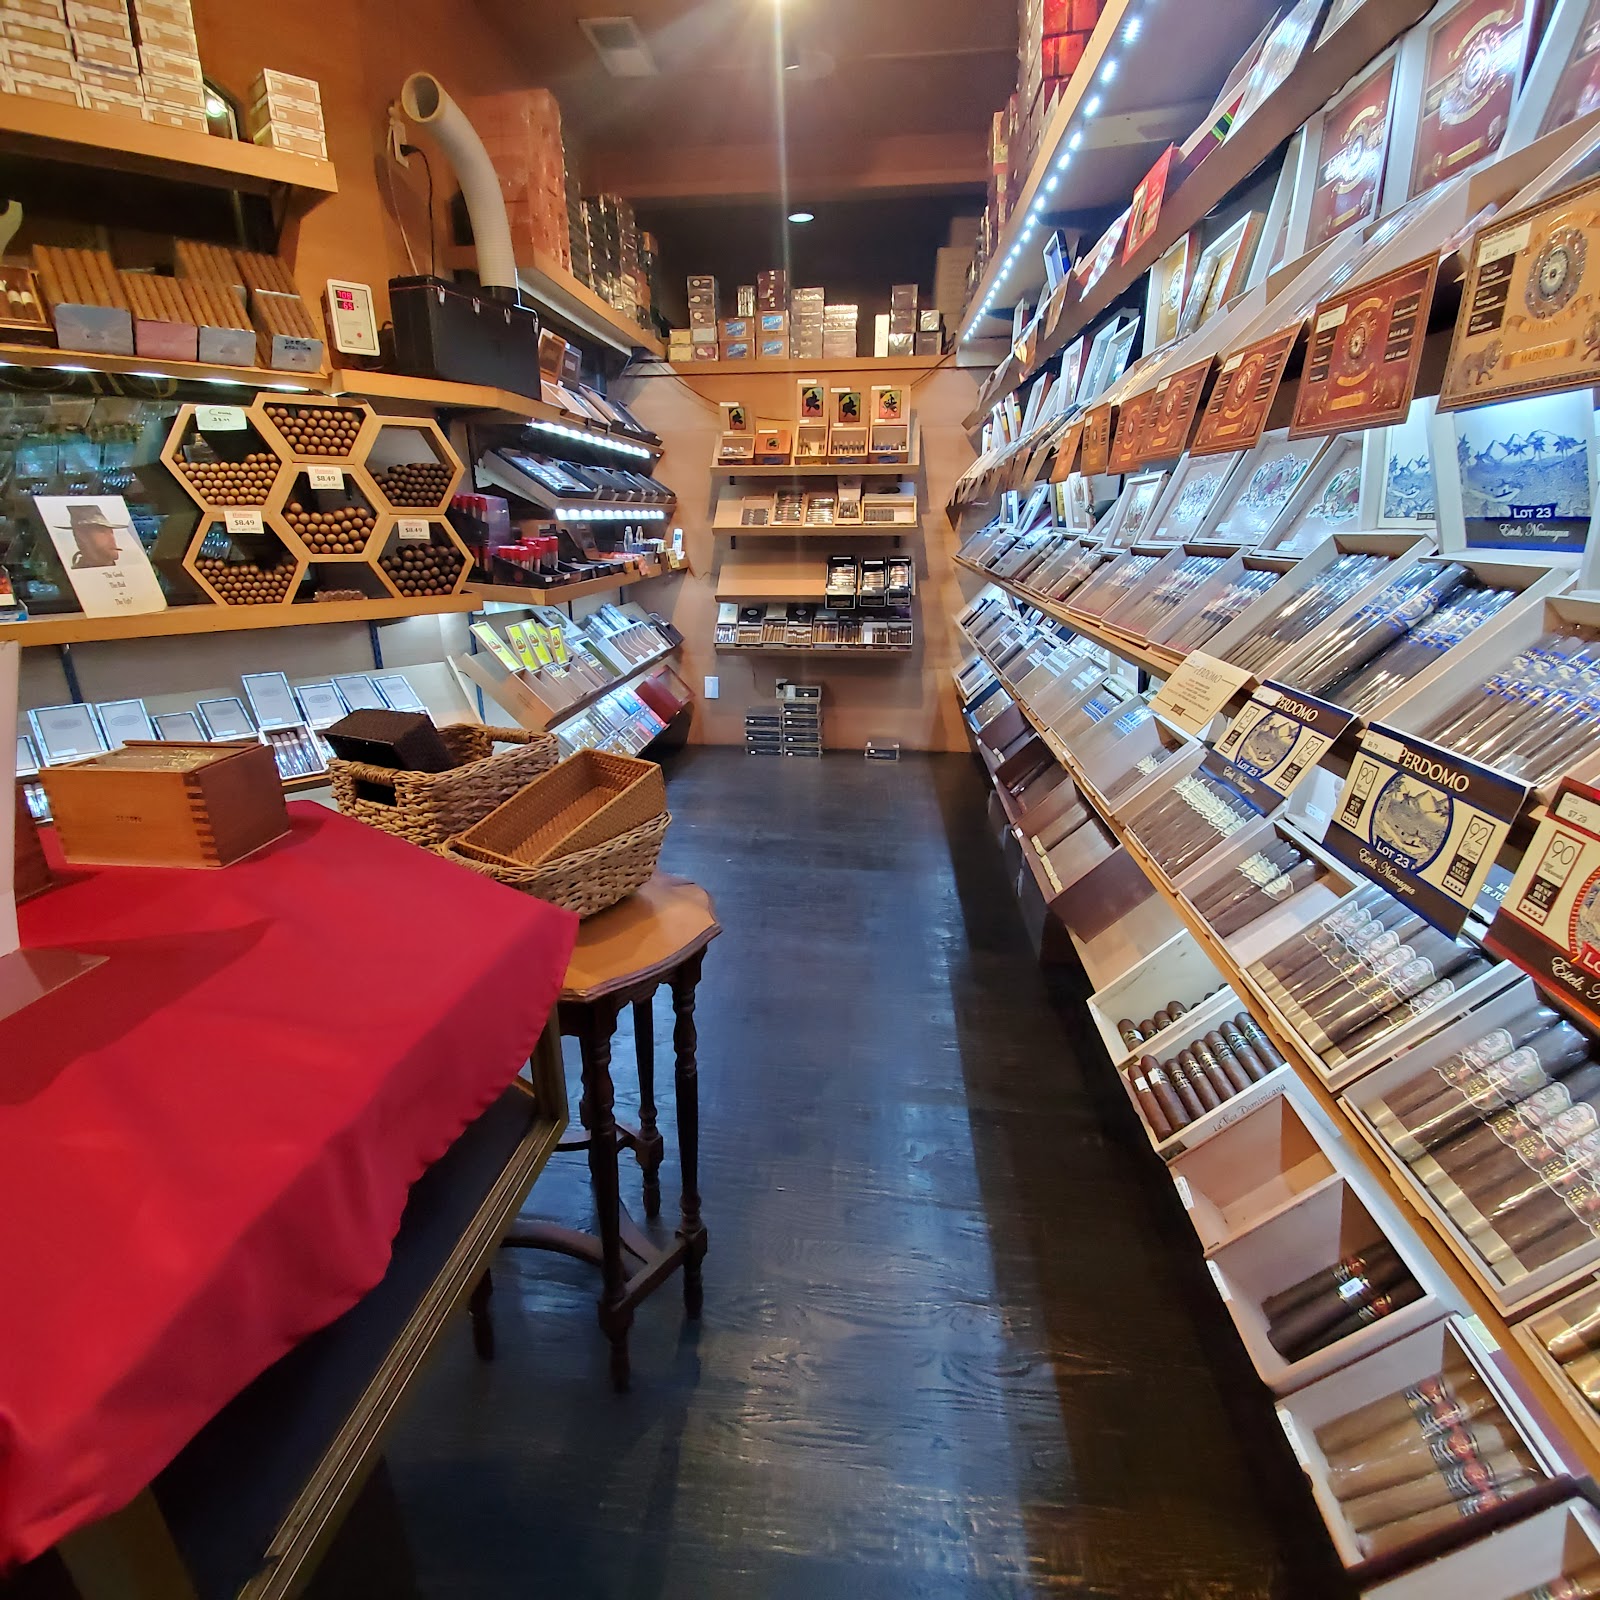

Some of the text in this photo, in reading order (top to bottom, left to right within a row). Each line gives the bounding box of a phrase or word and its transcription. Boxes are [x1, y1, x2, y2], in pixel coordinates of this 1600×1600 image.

[1513, 507, 1552, 519] LOT 23
[1305, 740, 1319, 756] 92
[1237, 759, 1259, 777] LOT 23
[1360, 767, 1374, 785] 90
[1469, 822, 1489, 846] 92
[1376, 840, 1410, 869] LOT 23
[1552, 840, 1576, 866] 90
[1377, 861, 1416, 895] Nicaragua
[1237, 1083, 1287, 1115] Dominicana
